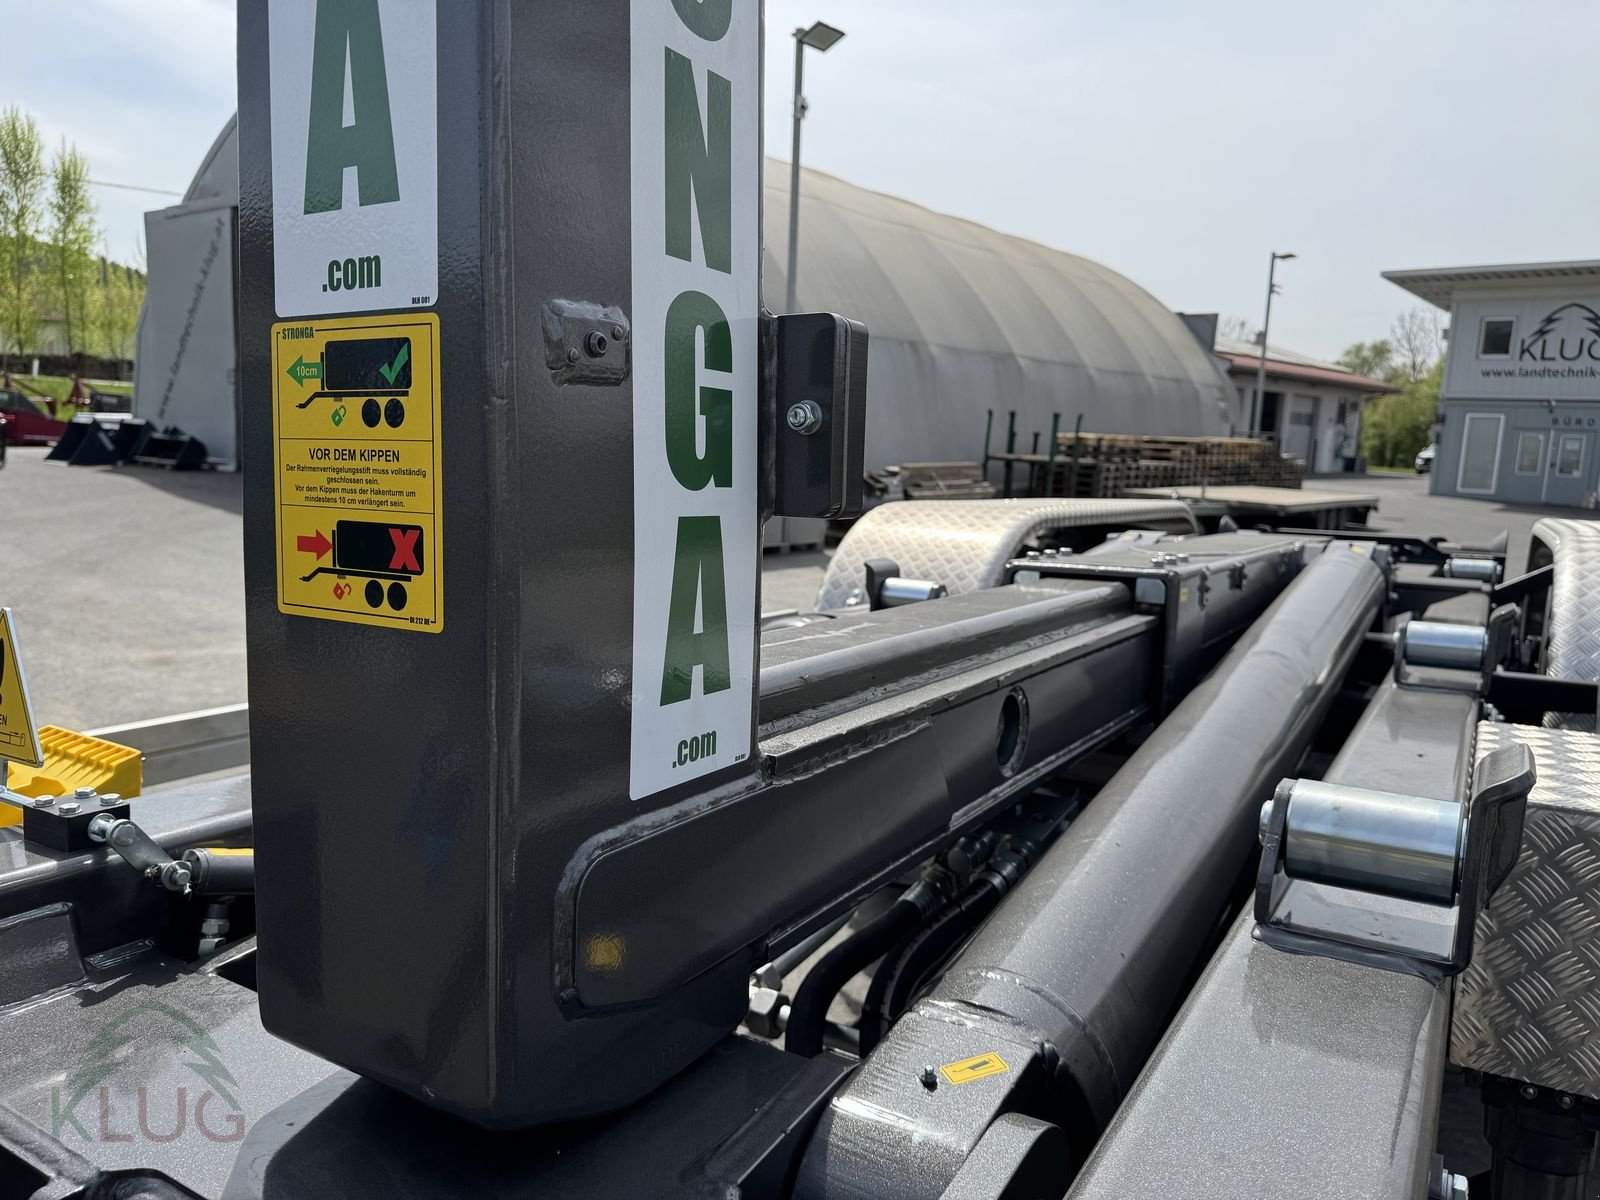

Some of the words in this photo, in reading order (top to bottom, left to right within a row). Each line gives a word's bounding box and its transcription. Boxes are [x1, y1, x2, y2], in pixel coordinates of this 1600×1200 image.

[304, 0, 400, 215] A
[322, 255, 381, 292] .com
[282, 327, 314, 340] STRONGA
[660, 0, 733, 707] NGA
[296, 366, 317, 376] 10cm
[309, 448, 331, 461] VOR
[334, 449, 356, 461] DEM
[359, 449, 400, 462] KIPPEN
[286, 464, 296, 472] Der
[296, 465, 371, 475] Rahmenverriegelungsstift
[390, 468, 427, 478] vollständig
[326, 476, 364, 484] geschlossen
[365, 477, 380, 485] sein.
[295, 484, 305, 492] Vor
[319, 485, 340, 494] Kippen
[358, 487, 369, 495] der
[370, 488, 404, 496] Hakenturm
[304, 494, 337, 503] mindestens
[338, 496, 346, 504] 10
[358, 497, 389, 508] verlängert
[390, 499, 406, 508] sein.
[672, 730, 717, 768] .com
